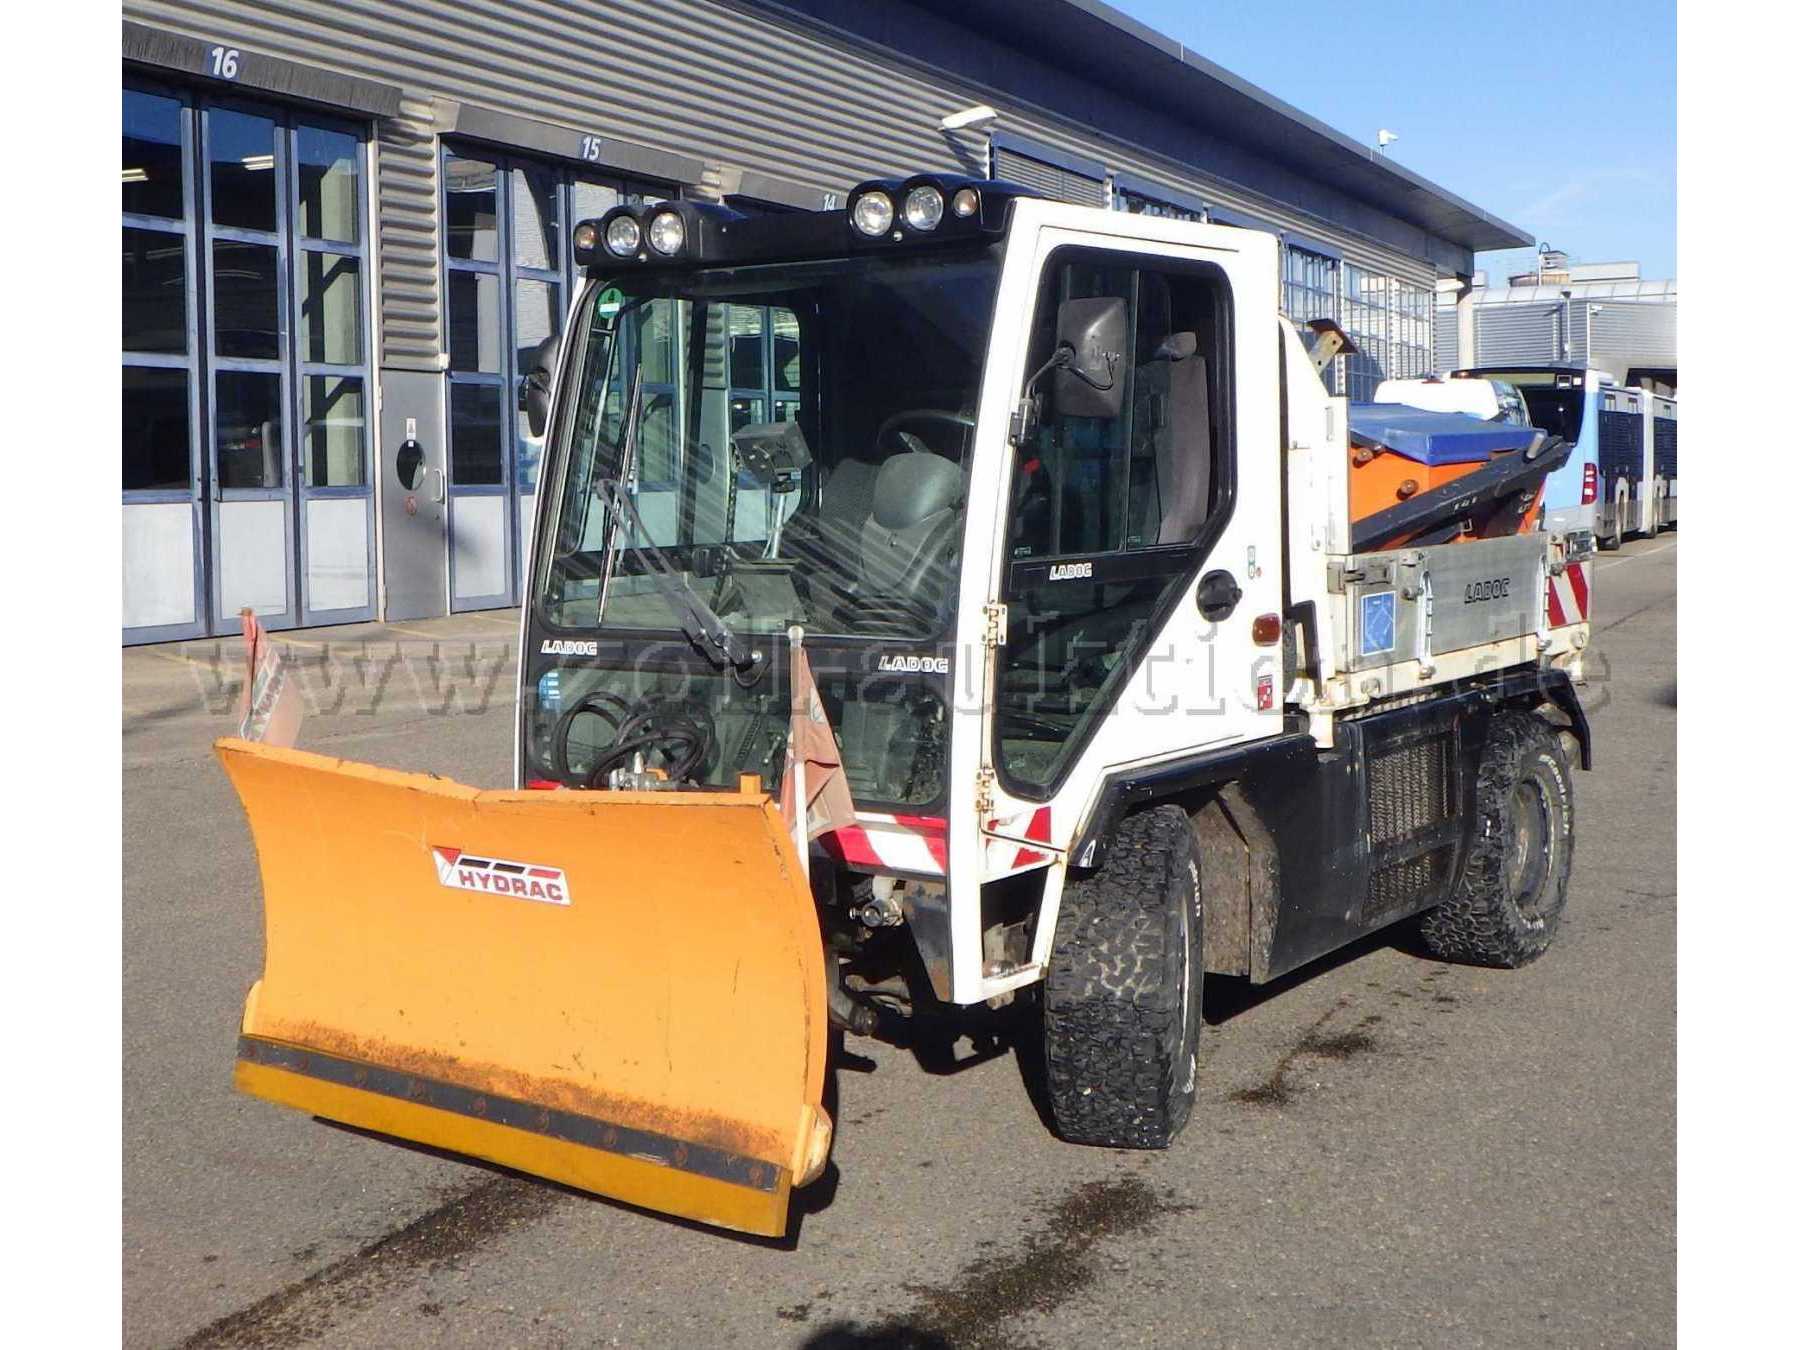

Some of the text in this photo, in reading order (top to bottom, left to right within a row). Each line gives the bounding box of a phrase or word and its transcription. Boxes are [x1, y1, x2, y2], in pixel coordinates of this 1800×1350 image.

[212, 46, 239, 79] 16
[583, 135, 601, 161] 15
[457, 868, 564, 901] HYDRAC
